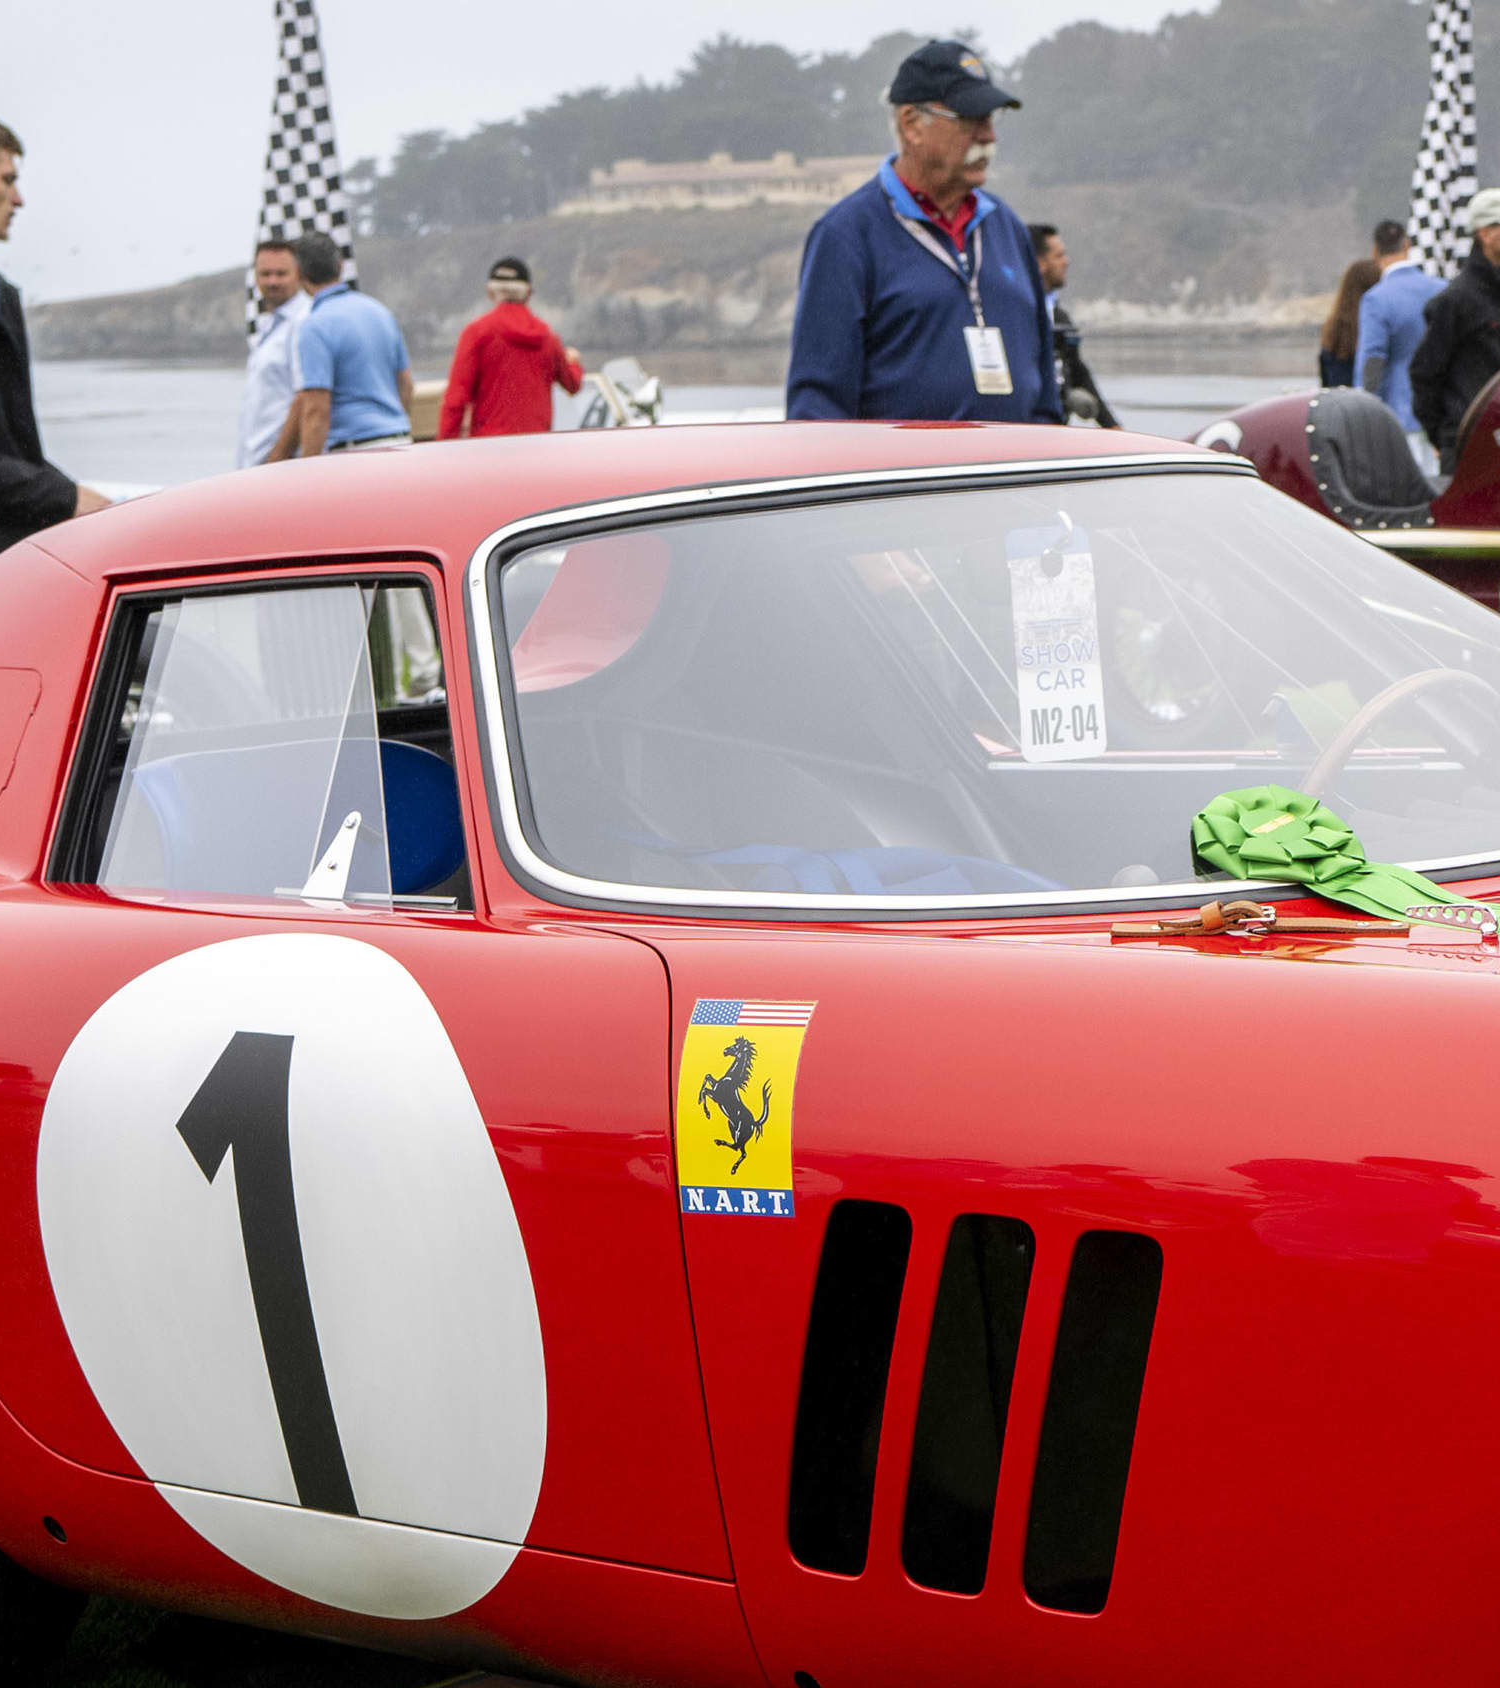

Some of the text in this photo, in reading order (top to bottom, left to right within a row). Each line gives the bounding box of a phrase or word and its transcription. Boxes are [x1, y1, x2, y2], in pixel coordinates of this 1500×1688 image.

[1021, 641, 1095, 667] SHOW
[1036, 668, 1085, 692] CAR
[1030, 704, 1099, 745] M2-04
[687, 1188, 790, 1215] N.A.R.T.
[175, 1031, 360, 1517] 1
